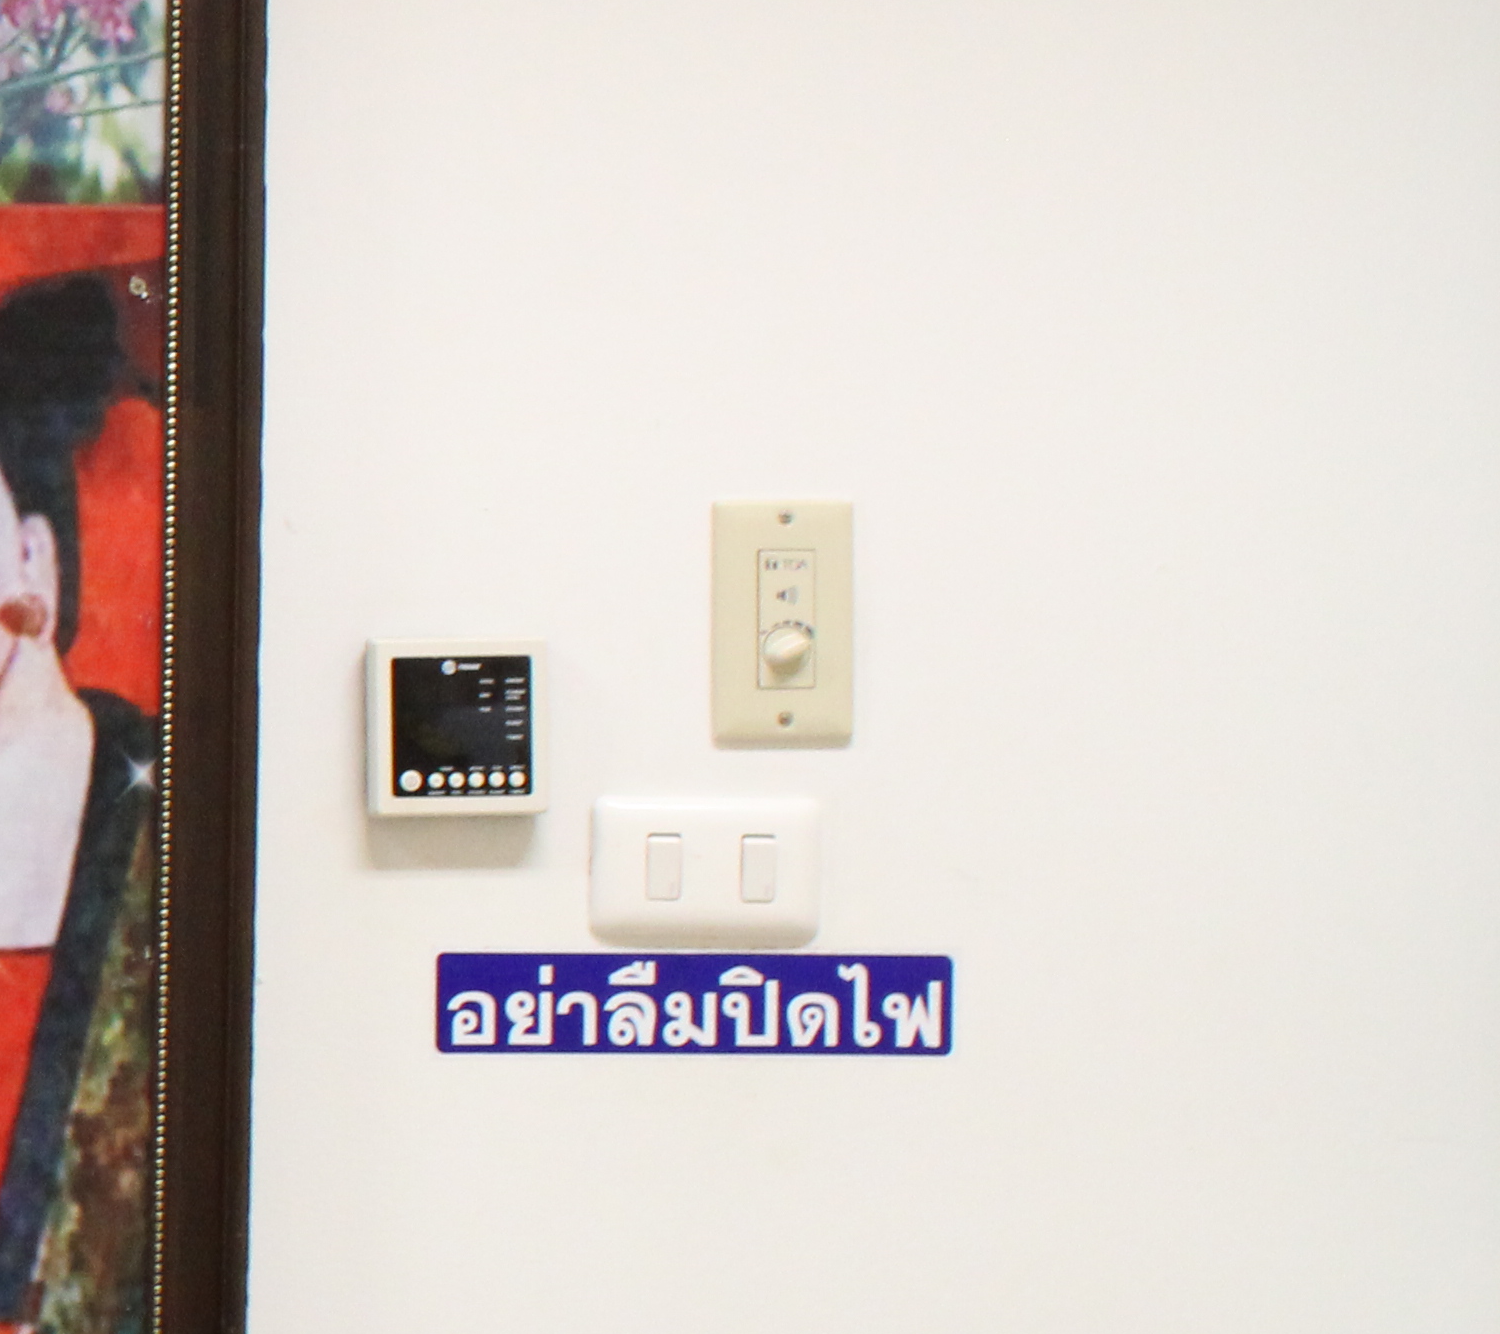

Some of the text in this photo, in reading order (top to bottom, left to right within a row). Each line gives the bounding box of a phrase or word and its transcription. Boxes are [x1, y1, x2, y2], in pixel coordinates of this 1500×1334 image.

[445, 961, 943, 1048] อย่าลืมปิดไฟ
